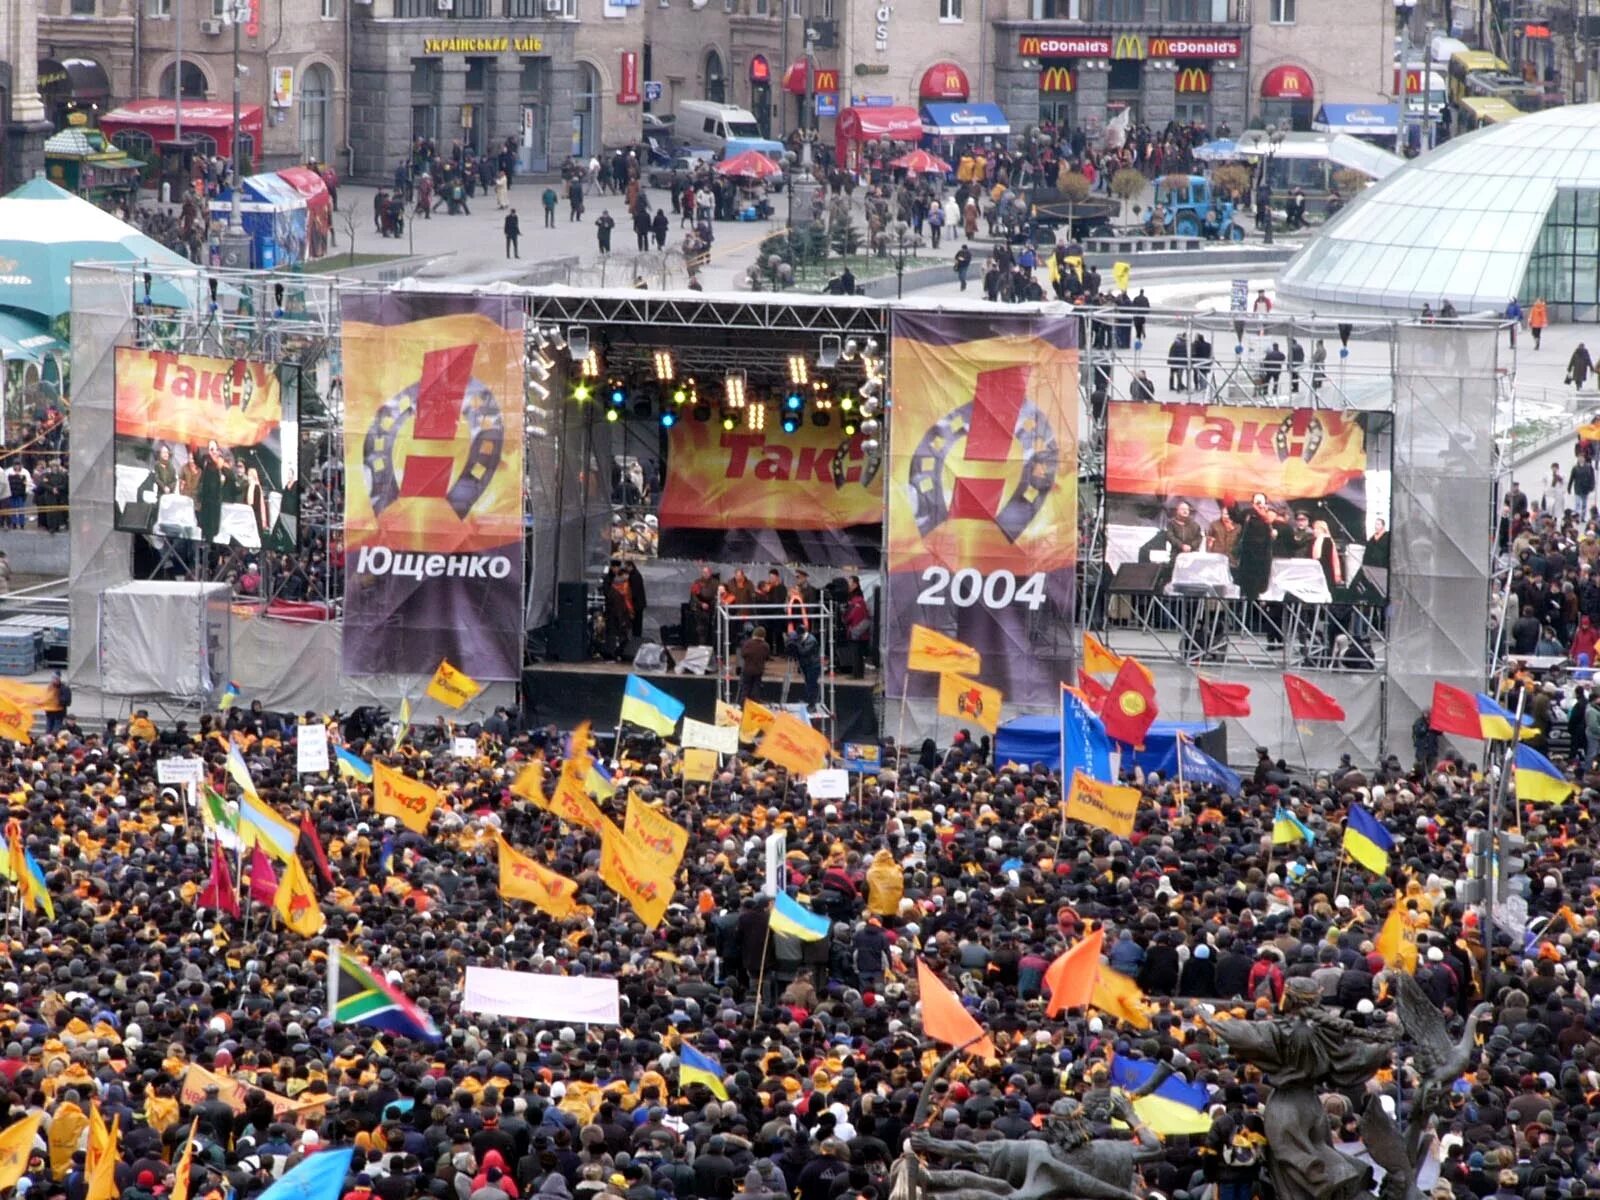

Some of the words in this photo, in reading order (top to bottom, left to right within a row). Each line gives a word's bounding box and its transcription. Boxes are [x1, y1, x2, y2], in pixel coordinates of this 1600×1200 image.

[1023, 37, 1109, 54] McDonald's
[1152, 39, 1237, 55] McDonald's
[356, 545, 513, 581] Ющенко
[916, 565, 1048, 611] 2004
